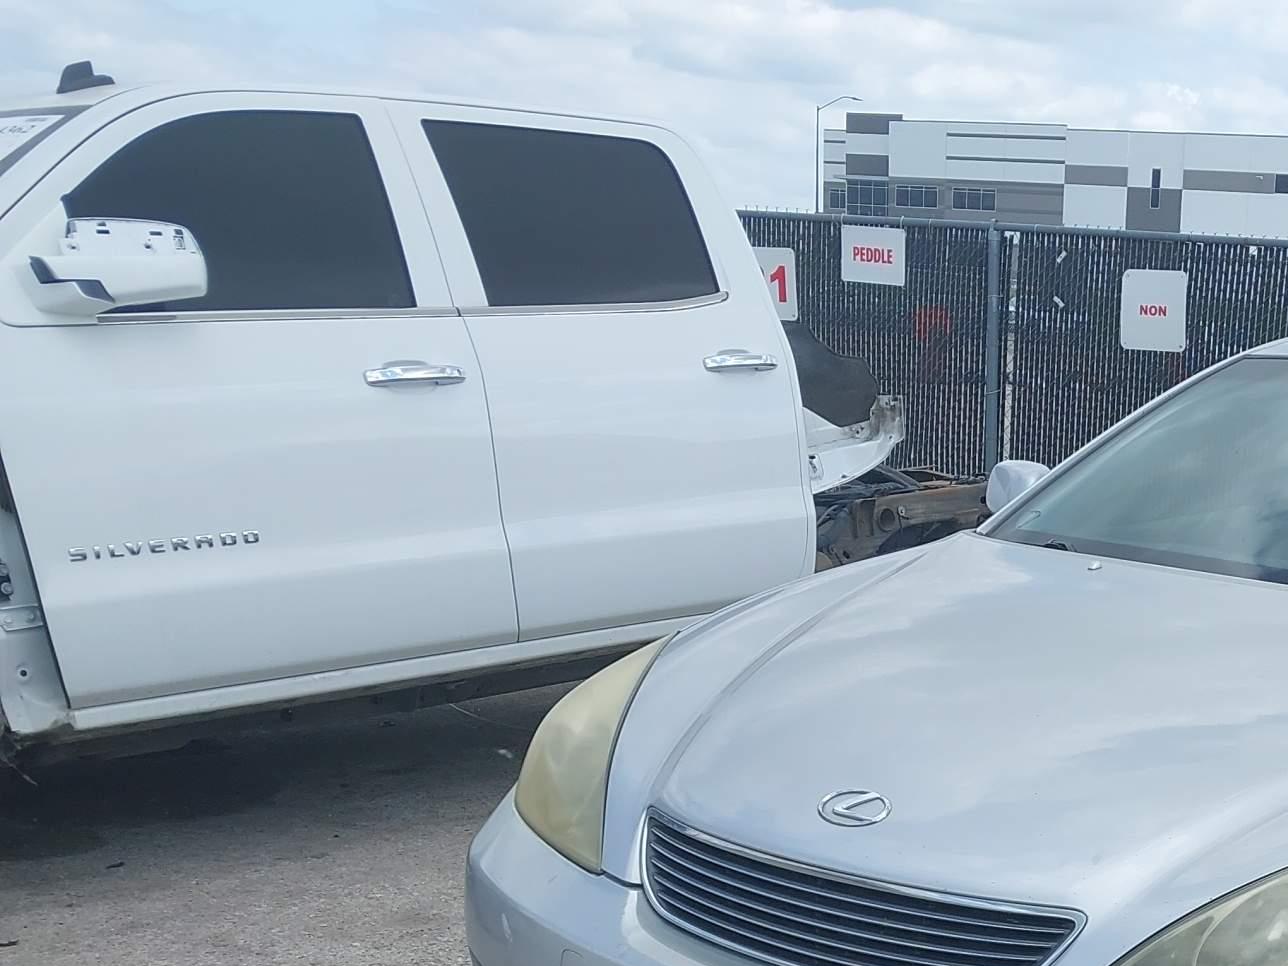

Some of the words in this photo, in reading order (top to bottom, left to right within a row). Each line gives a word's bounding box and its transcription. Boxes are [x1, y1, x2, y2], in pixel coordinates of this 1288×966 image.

[852, 246, 893, 265] PEDDLE
[1139, 304, 1167, 317] NON
[68, 529, 260, 562] SILVERADO
